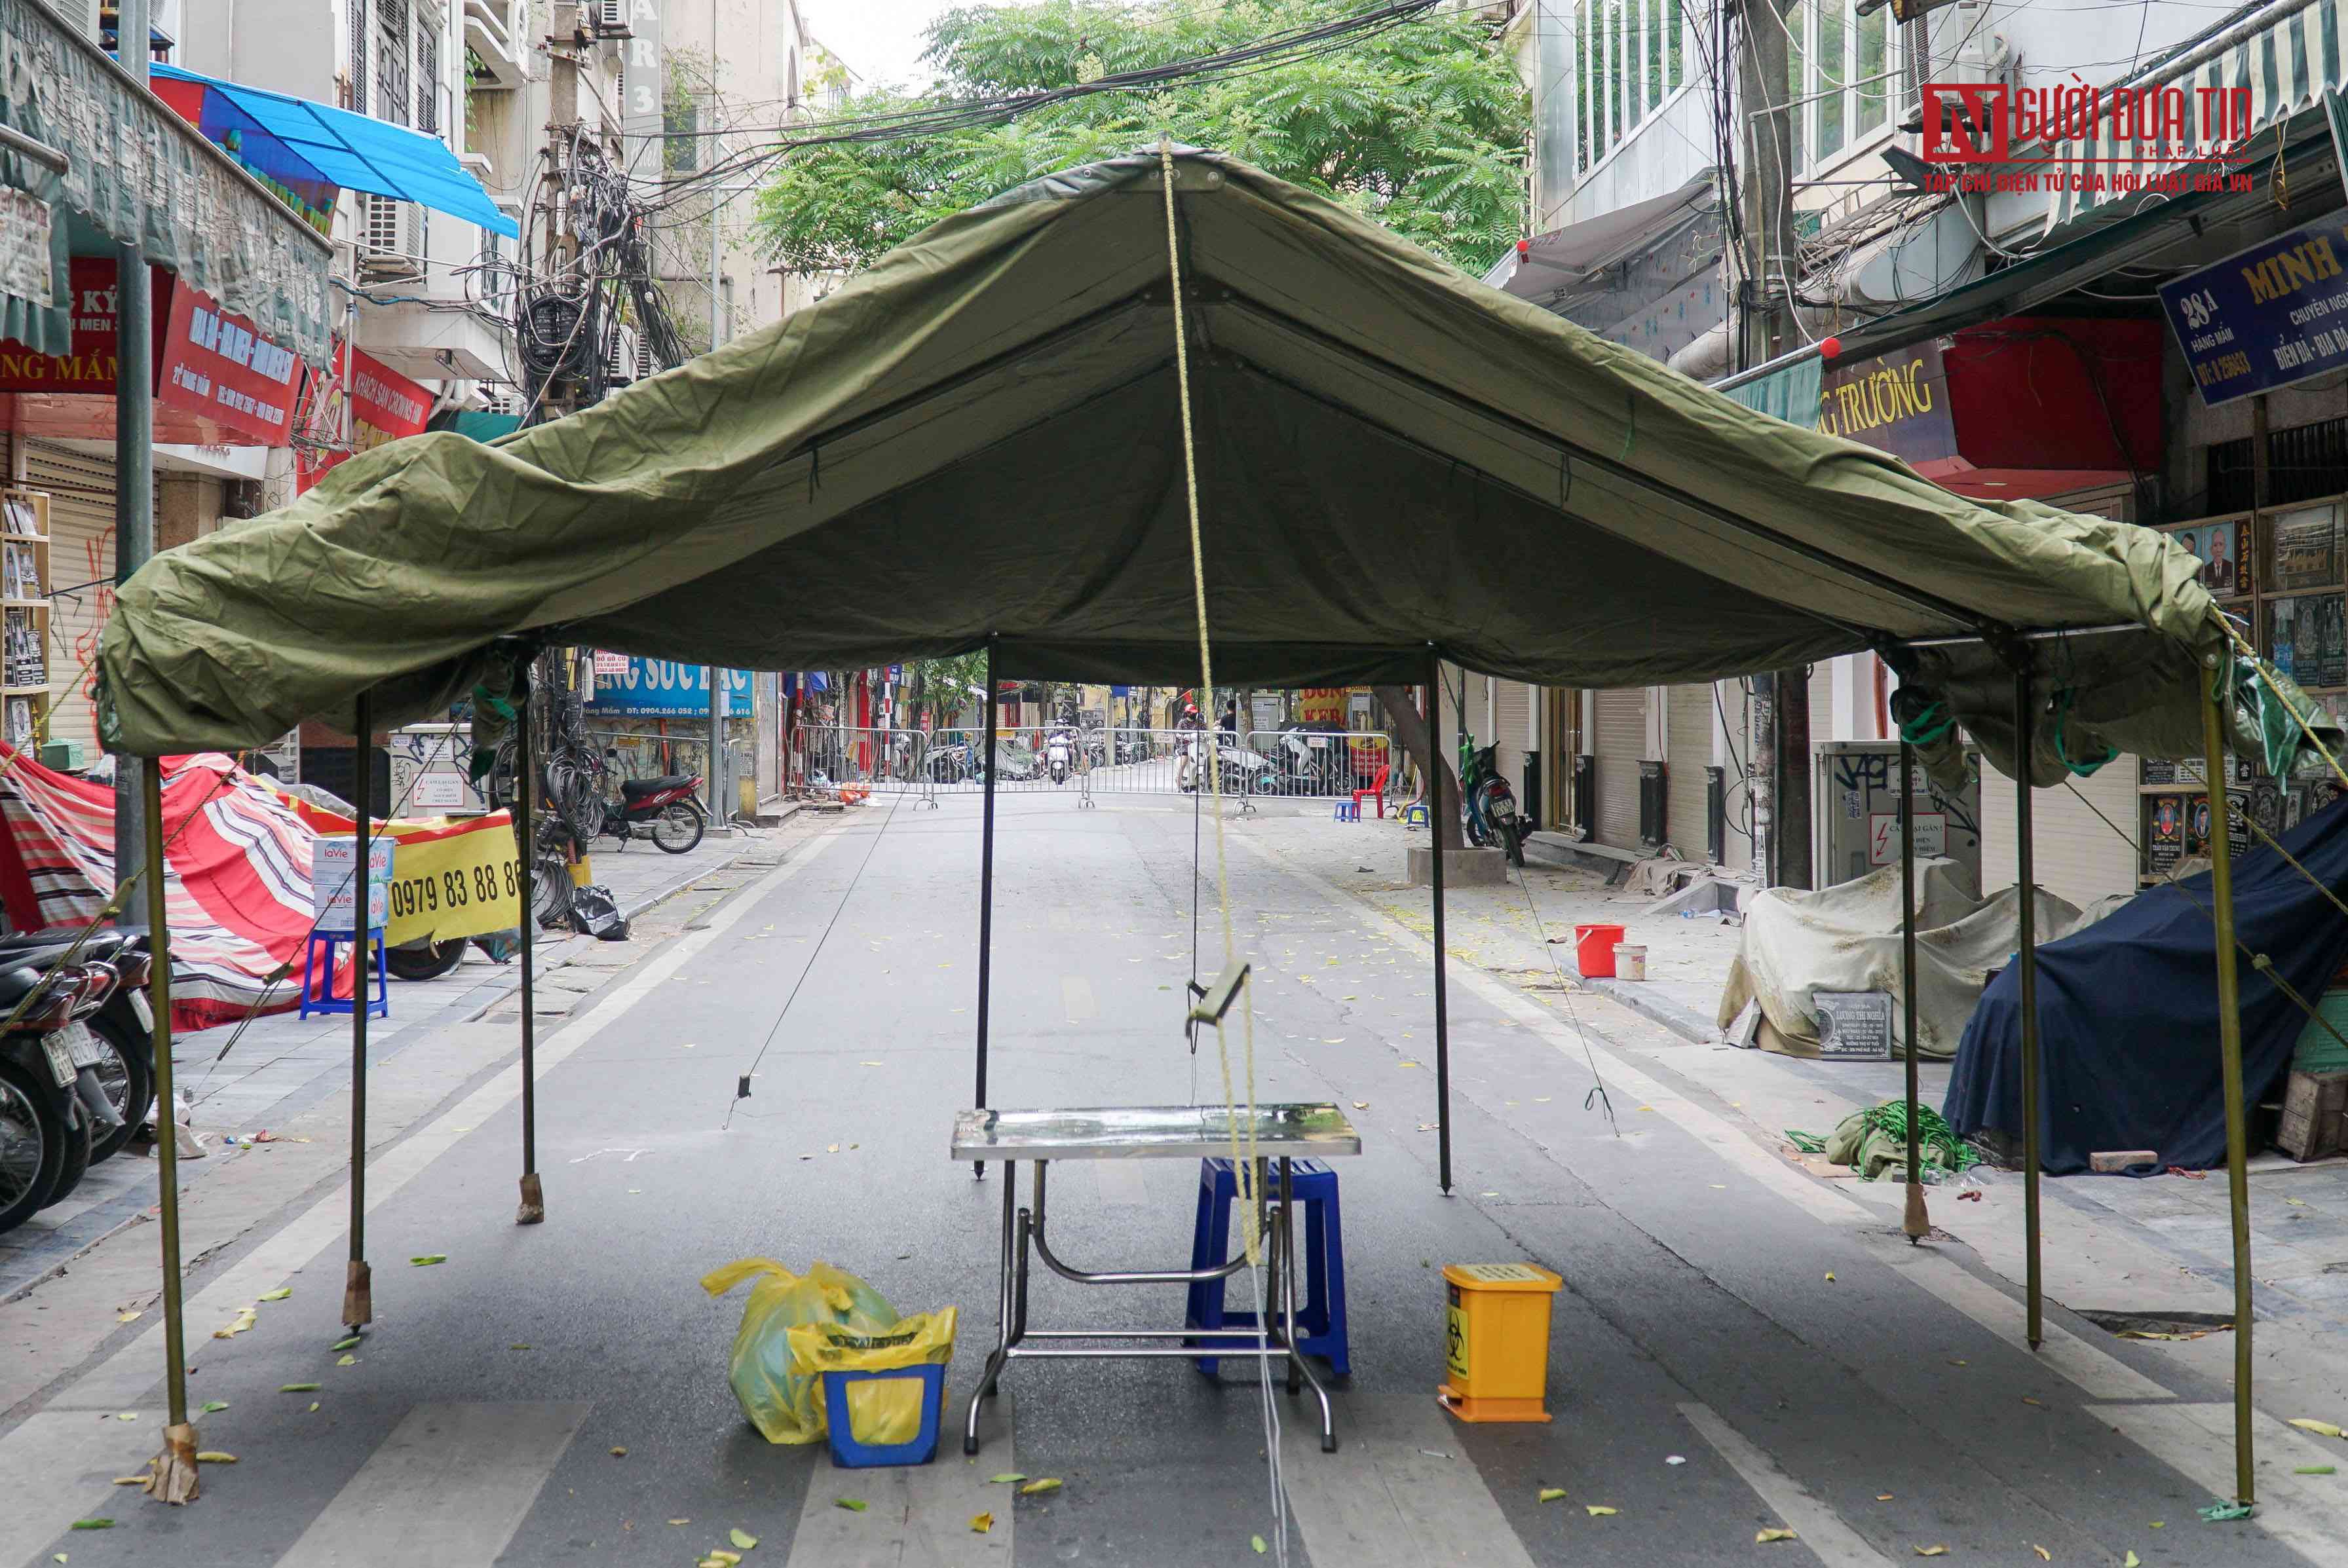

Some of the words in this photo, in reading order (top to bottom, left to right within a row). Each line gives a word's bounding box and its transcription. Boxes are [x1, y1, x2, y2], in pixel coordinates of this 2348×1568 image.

[2241, 235, 2343, 305] MINH
[80, 318, 111, 331] MEN
[2290, 298, 2330, 326] CHUYÊN
[2191, 334, 2216, 353] HÀNG
[2273, 333, 2300, 370] BIỂN
[2294, 333, 2315, 364] ĐÁ
[2313, 331, 2338, 358] BIA
[1836, 356, 1932, 436] TRƯỜNG
[324, 849, 349, 858] laVie
[369, 850, 387, 869] aVie
[328, 895, 352, 905] laVie
[391, 876, 438, 917] 0979
[444, 869, 468, 908] 83
[474, 864, 498, 903] 88
